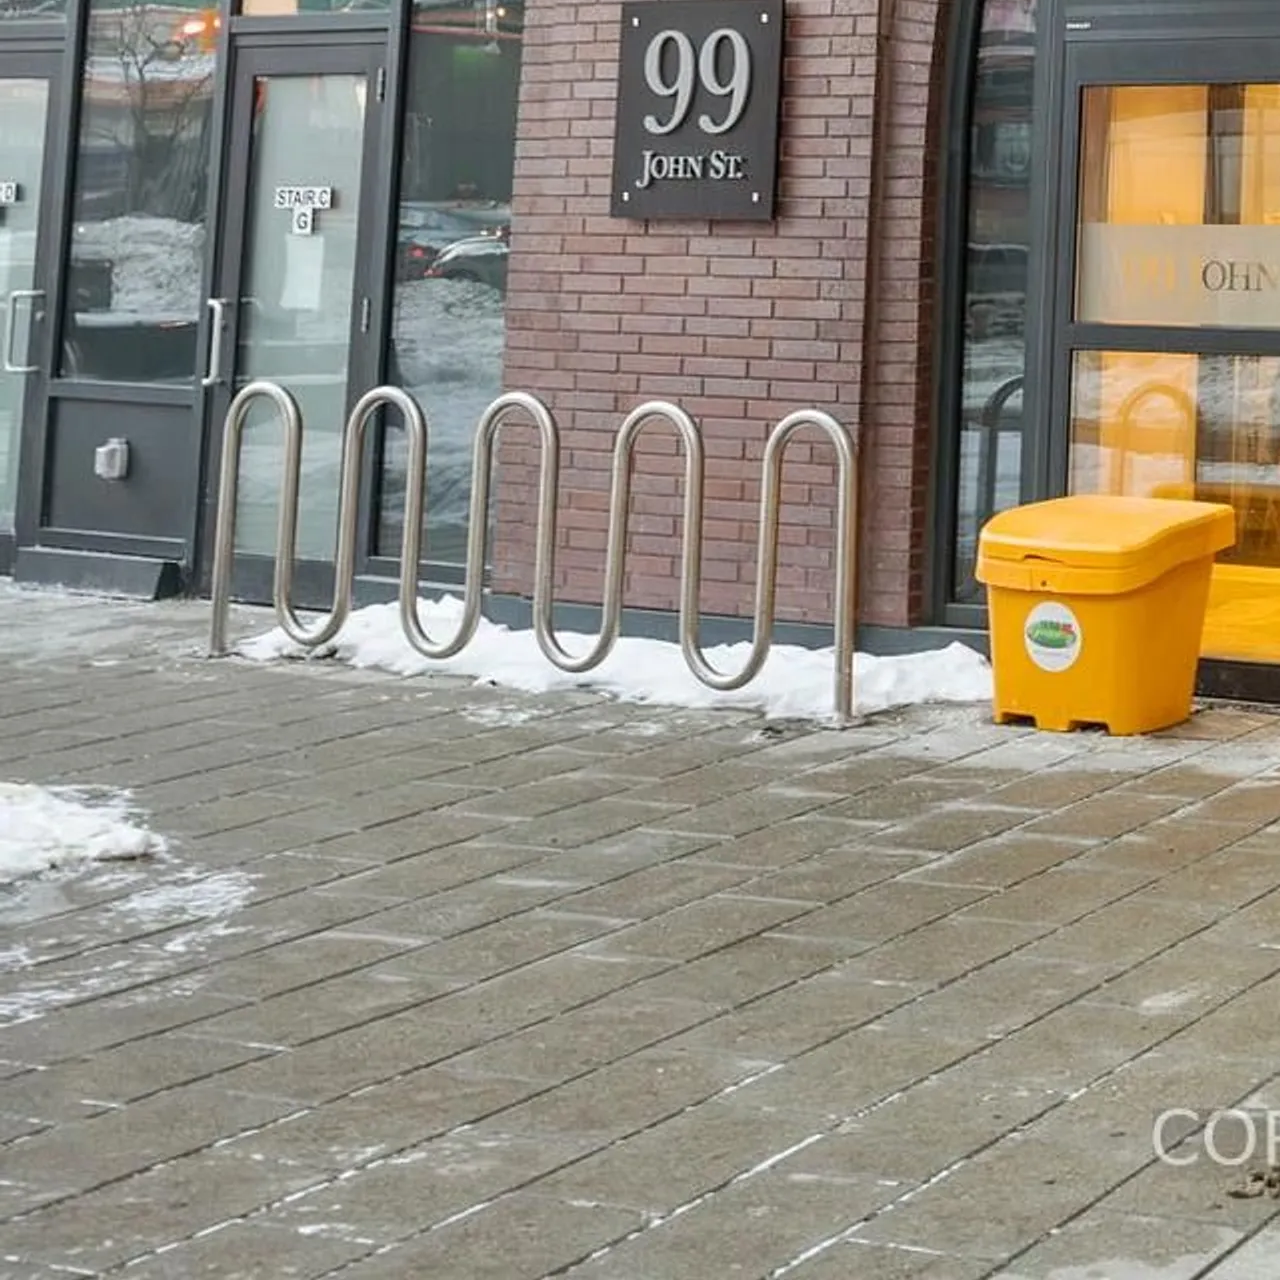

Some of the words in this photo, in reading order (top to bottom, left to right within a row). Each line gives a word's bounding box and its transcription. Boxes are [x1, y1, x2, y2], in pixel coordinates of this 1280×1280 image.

[643, 28, 750, 134] 99
[635, 149, 703, 188] JOHN
[709, 149, 744, 179] ST.
[277, 189, 316, 206] STAIR
[296, 211, 309, 229] G
